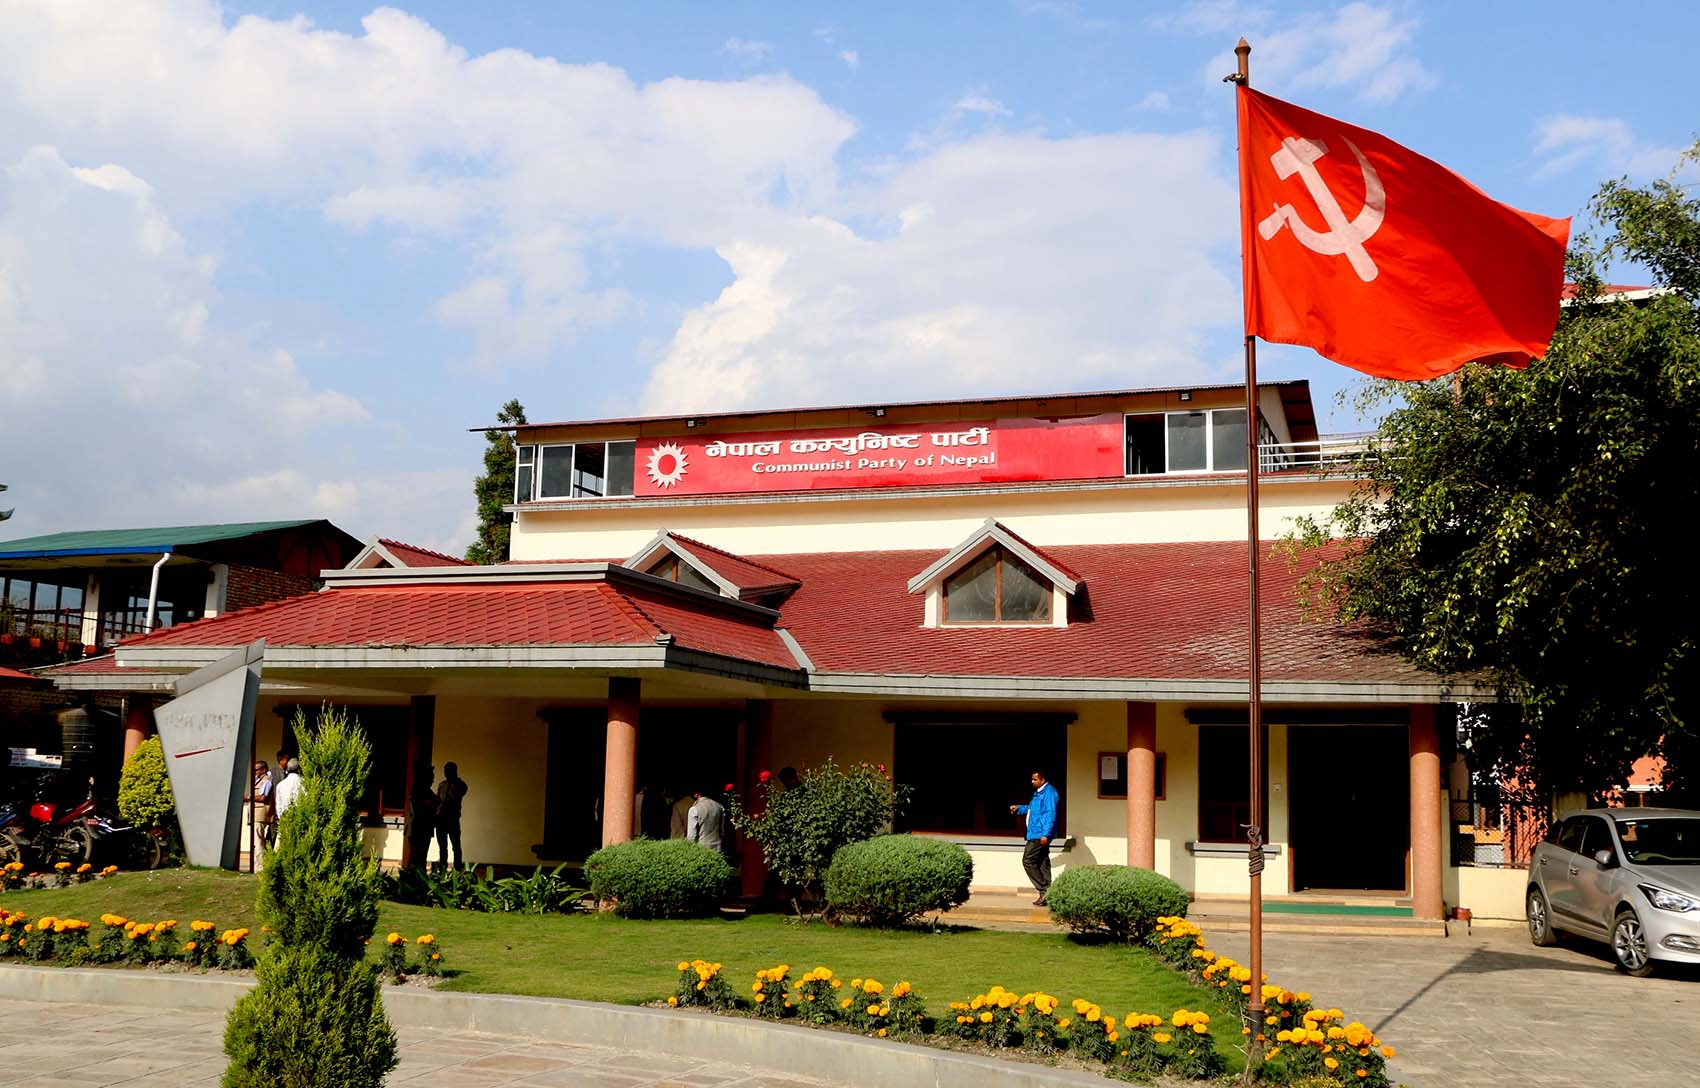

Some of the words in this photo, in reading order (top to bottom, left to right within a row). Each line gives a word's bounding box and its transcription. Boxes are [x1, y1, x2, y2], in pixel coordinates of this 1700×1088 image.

[705, 440, 783, 457] नेपाल
[789, 432, 922, 456] कम्युनिष्ट
[930, 427, 991, 447] पार्टी
[751, 459, 852, 473] Communist
[858, 457, 907, 471] Party
[914, 454, 935, 467] of
[940, 451, 996, 468] Nepal
